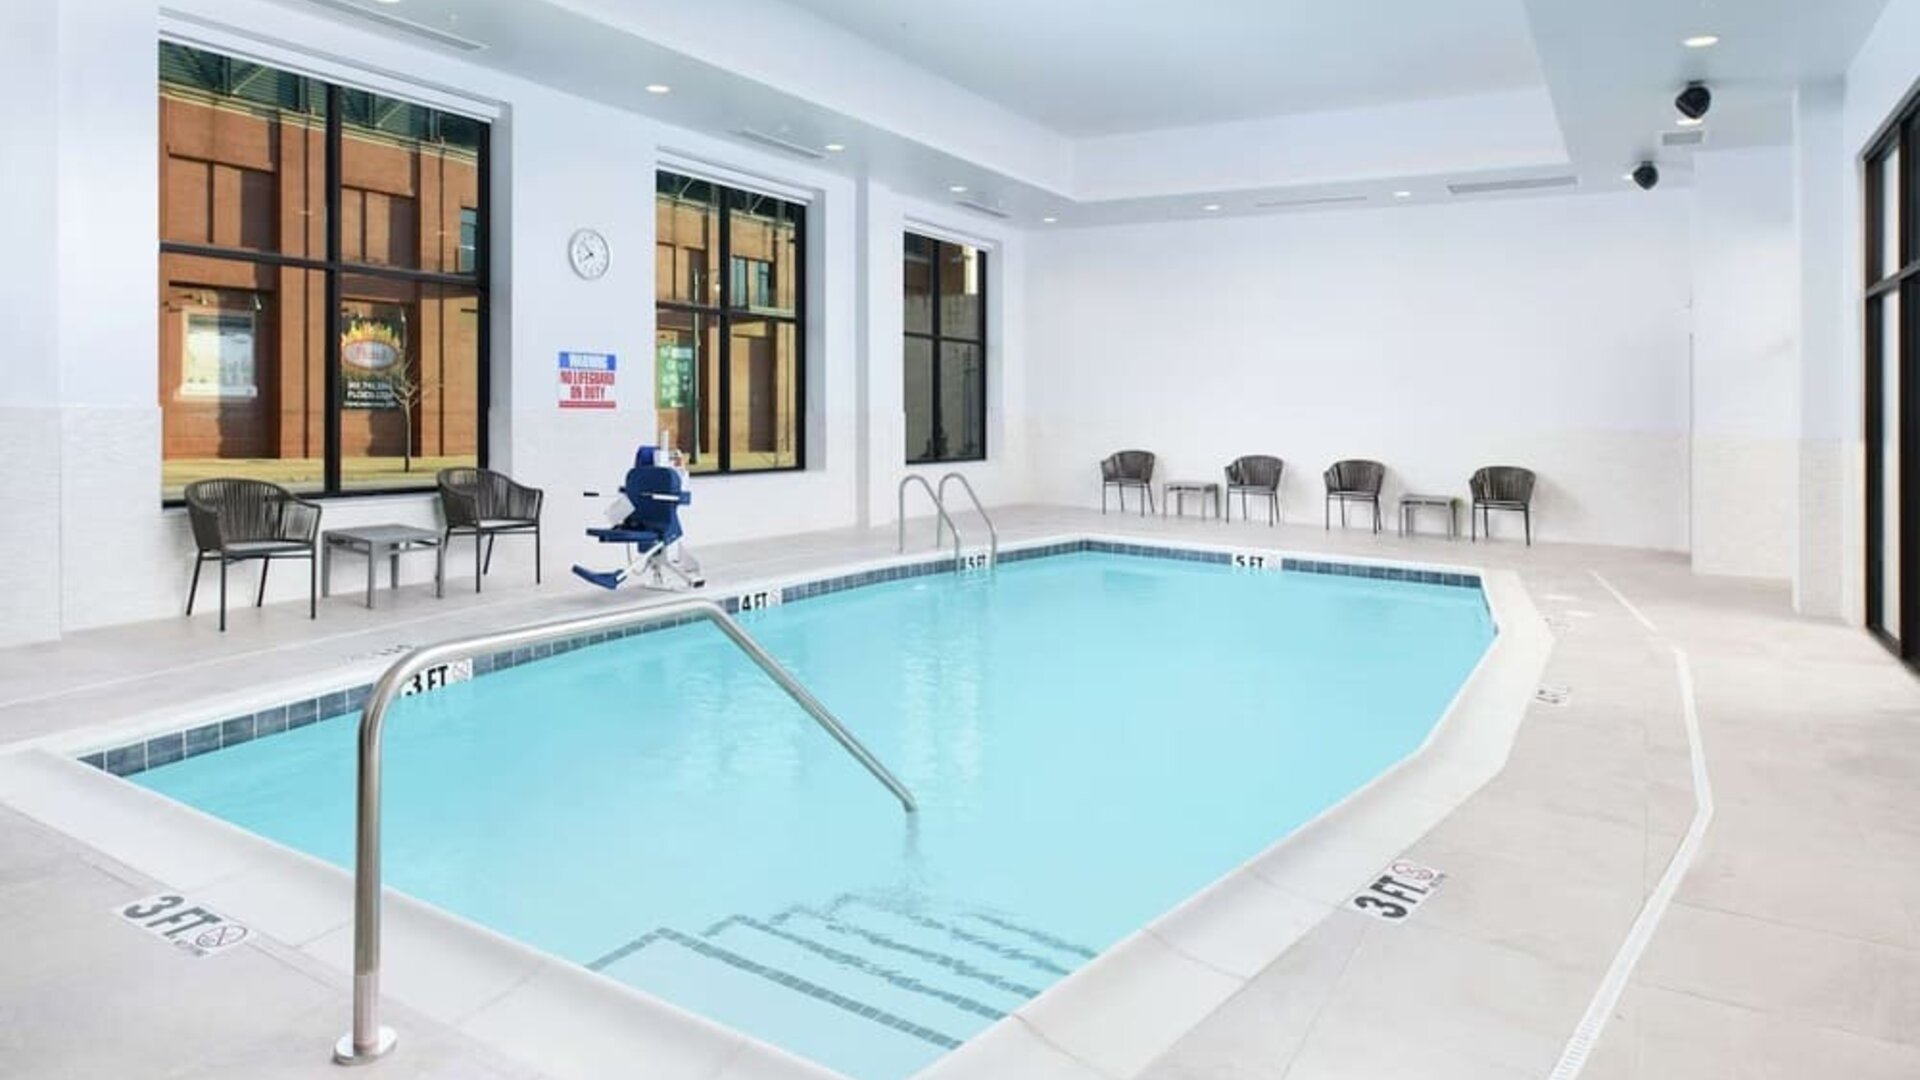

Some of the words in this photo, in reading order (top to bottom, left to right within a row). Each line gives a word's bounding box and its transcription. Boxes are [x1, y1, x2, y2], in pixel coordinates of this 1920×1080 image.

[560, 370, 572, 384] NO
[573, 370, 615, 385] LIFEGUARD
[571, 386, 582, 399] ON
[584, 386, 605, 400] DUTY
[1236, 555, 1245, 567] 5
[1249, 556, 1264, 570] FT
[742, 595, 751, 611] 4
[754, 592, 768, 609] FT
[405, 673, 422, 695] 3
[427, 664, 448, 691] FT
[1369, 874, 1428, 905] FT
[123, 895, 185, 919] 3
[1354, 895, 1408, 918] 3
[145, 906, 223, 937] FT
